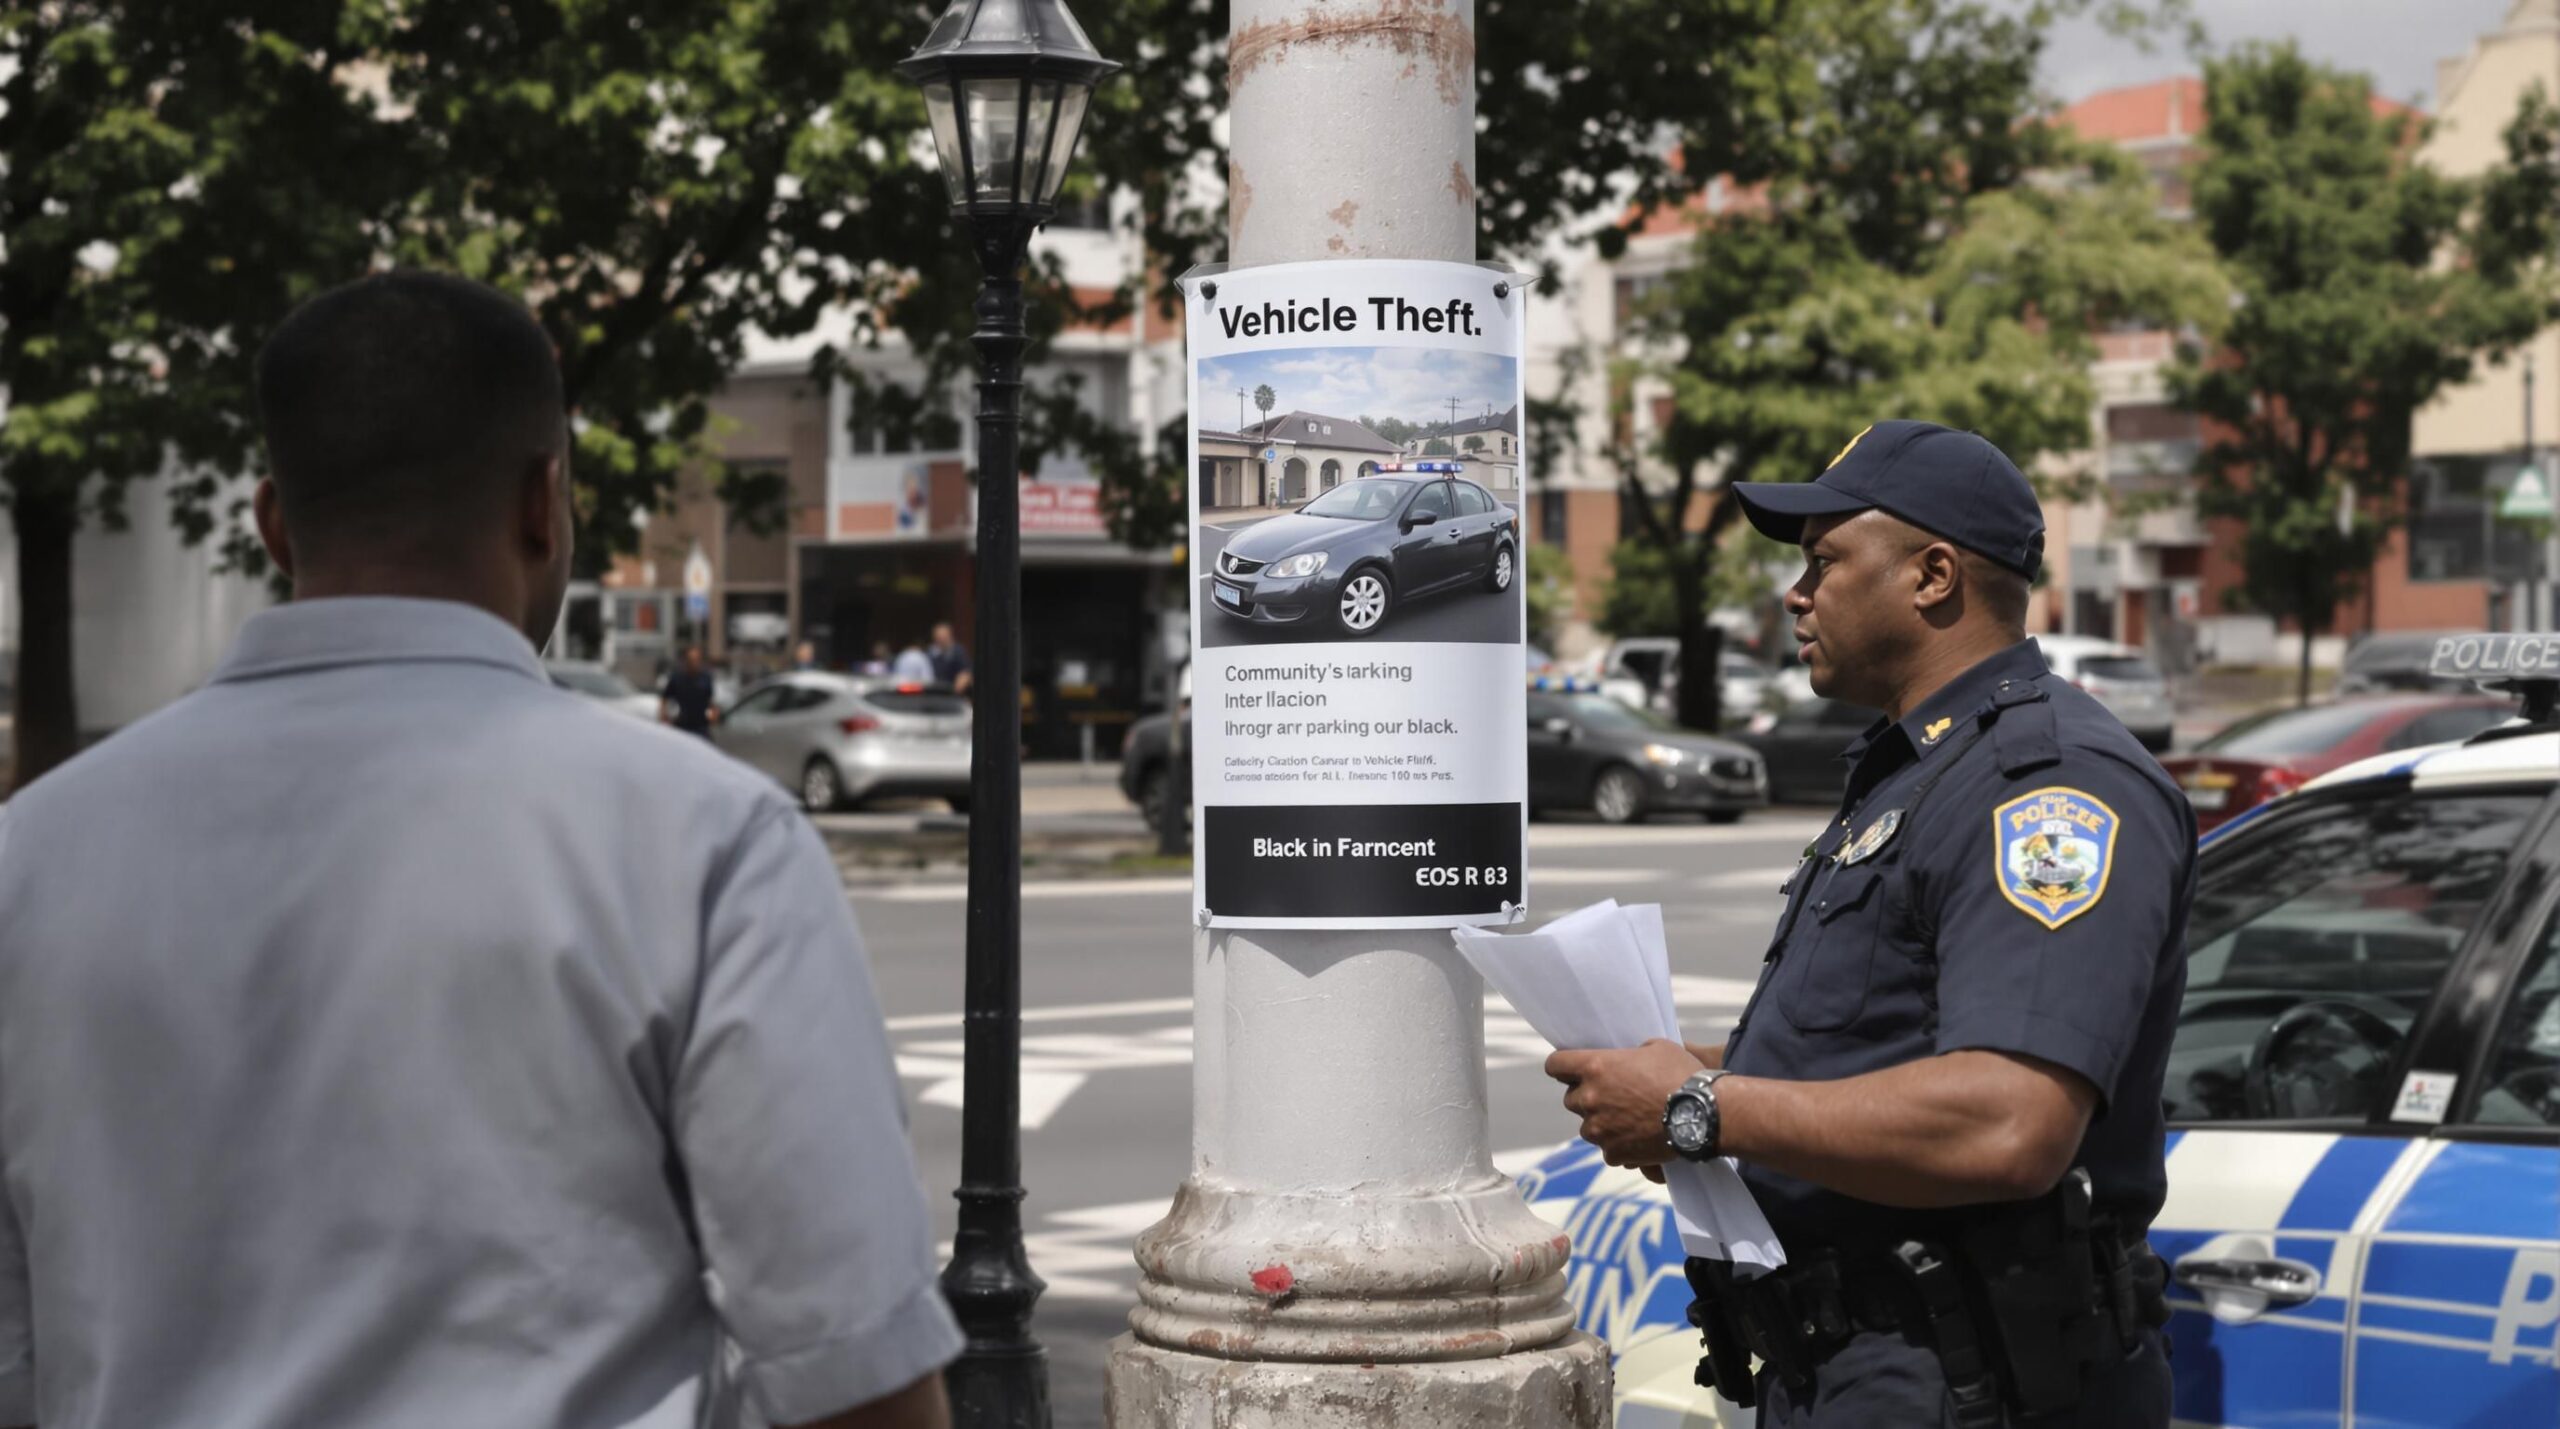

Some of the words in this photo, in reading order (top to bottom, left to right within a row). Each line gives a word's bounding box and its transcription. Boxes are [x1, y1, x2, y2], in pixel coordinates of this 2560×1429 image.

[1219, 298, 1357, 338] Vehicle
[1368, 297, 1481, 336] Theft.
[2431, 637, 2560, 669] POLICE
[1225, 663, 1343, 683] Community's
[1307, 719, 1369, 737] parking
[1374, 722, 1403, 734] our
[1408, 719, 1458, 734] black.
[1364, 755, 1404, 765] Vehicle
[1252, 837, 1308, 858] Black
[1312, 838, 1332, 858] in
[1415, 866, 1460, 887] EOS
[1464, 866, 1479, 886] R
